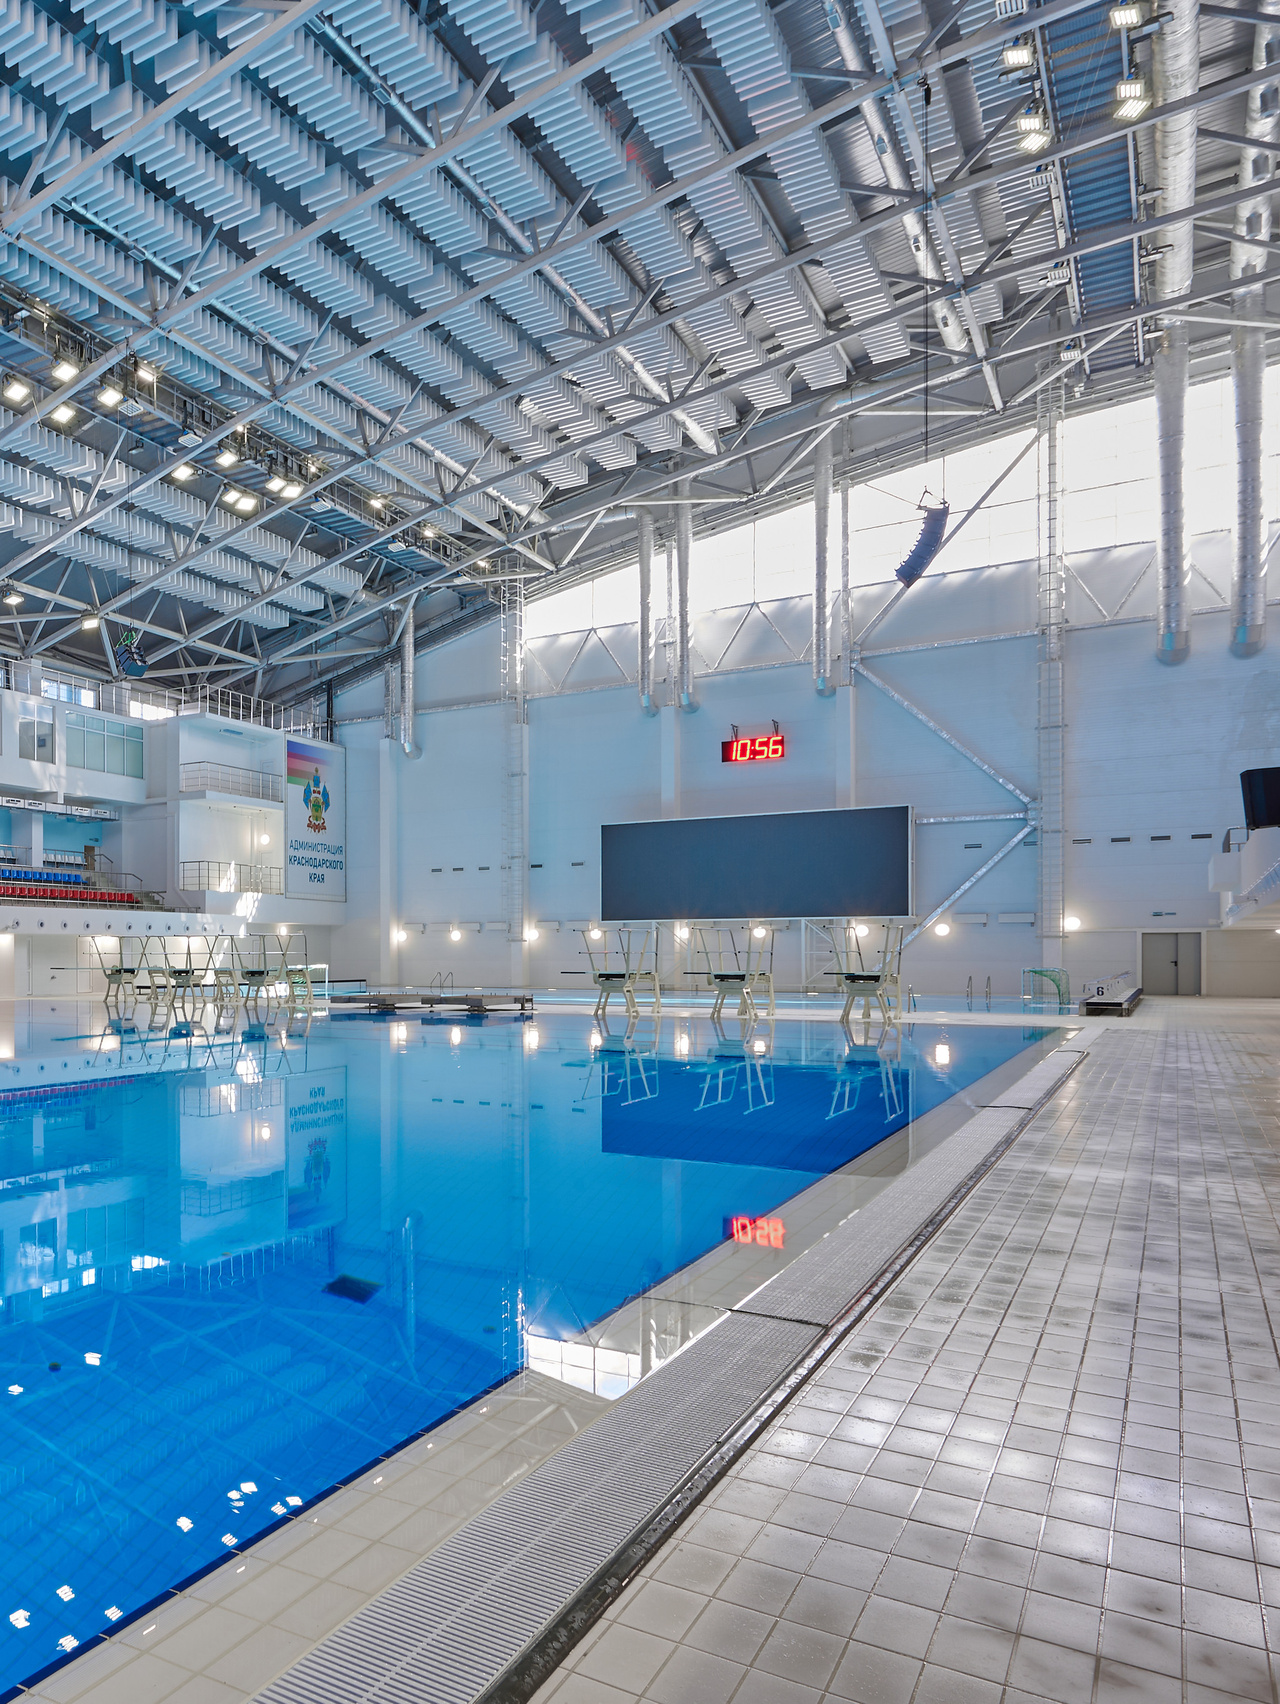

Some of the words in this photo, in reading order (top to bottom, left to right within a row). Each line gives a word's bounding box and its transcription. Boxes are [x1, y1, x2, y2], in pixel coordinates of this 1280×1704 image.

[732, 736, 782, 760] 10:56
[289, 839, 343, 856] АДМИНИСТРАЦИЯ
[288, 854, 343, 870] КРАСНОДАРСКОГО
[309, 872, 325, 883] КРАЯ
[1096, 986, 1105, 996] 6
